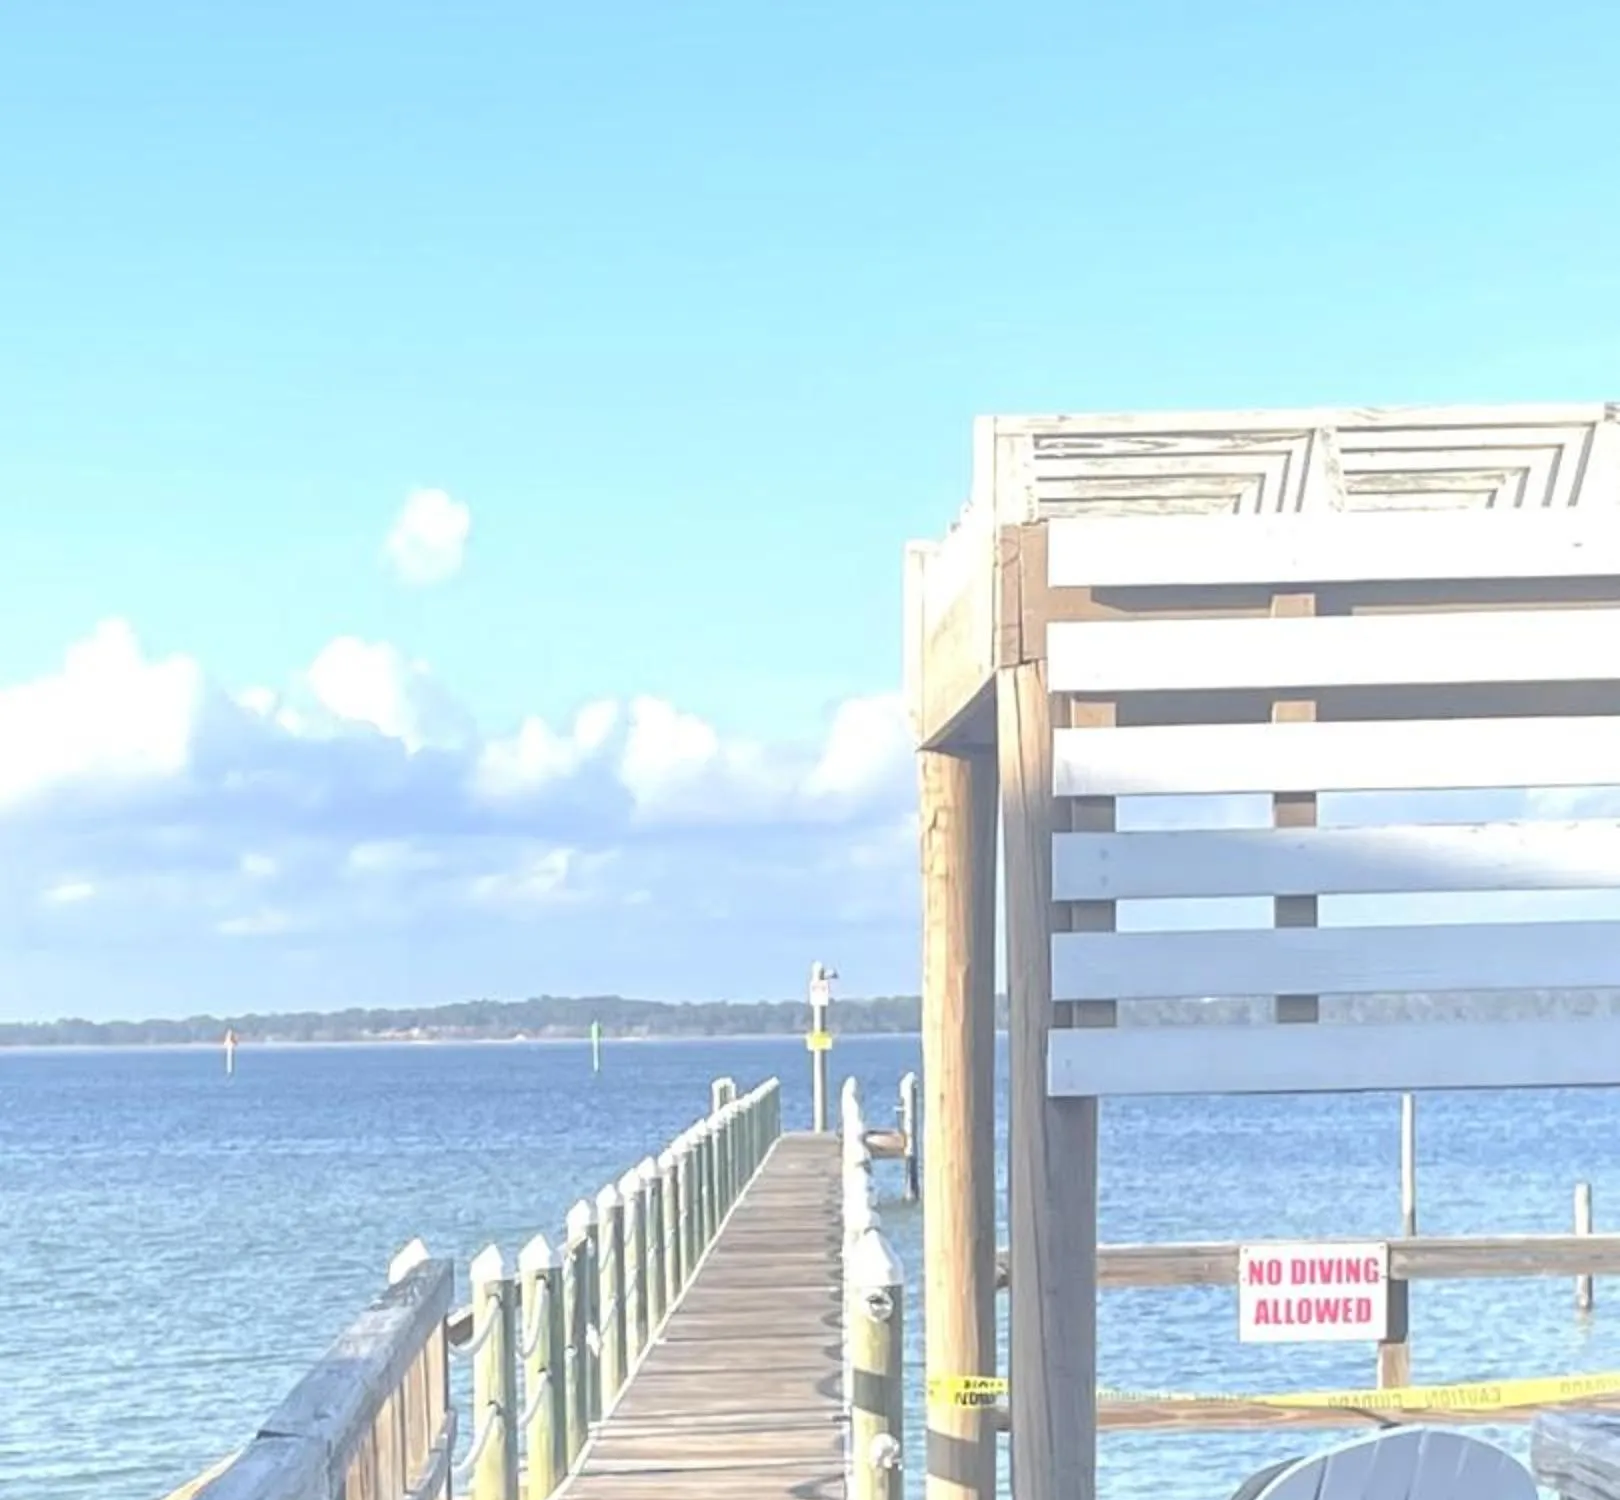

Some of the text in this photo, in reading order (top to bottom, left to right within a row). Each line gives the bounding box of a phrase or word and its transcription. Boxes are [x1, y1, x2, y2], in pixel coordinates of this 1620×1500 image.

[1249, 1258, 1380, 1285] NO DIVING
[1254, 1298, 1372, 1324] ALLOWED
